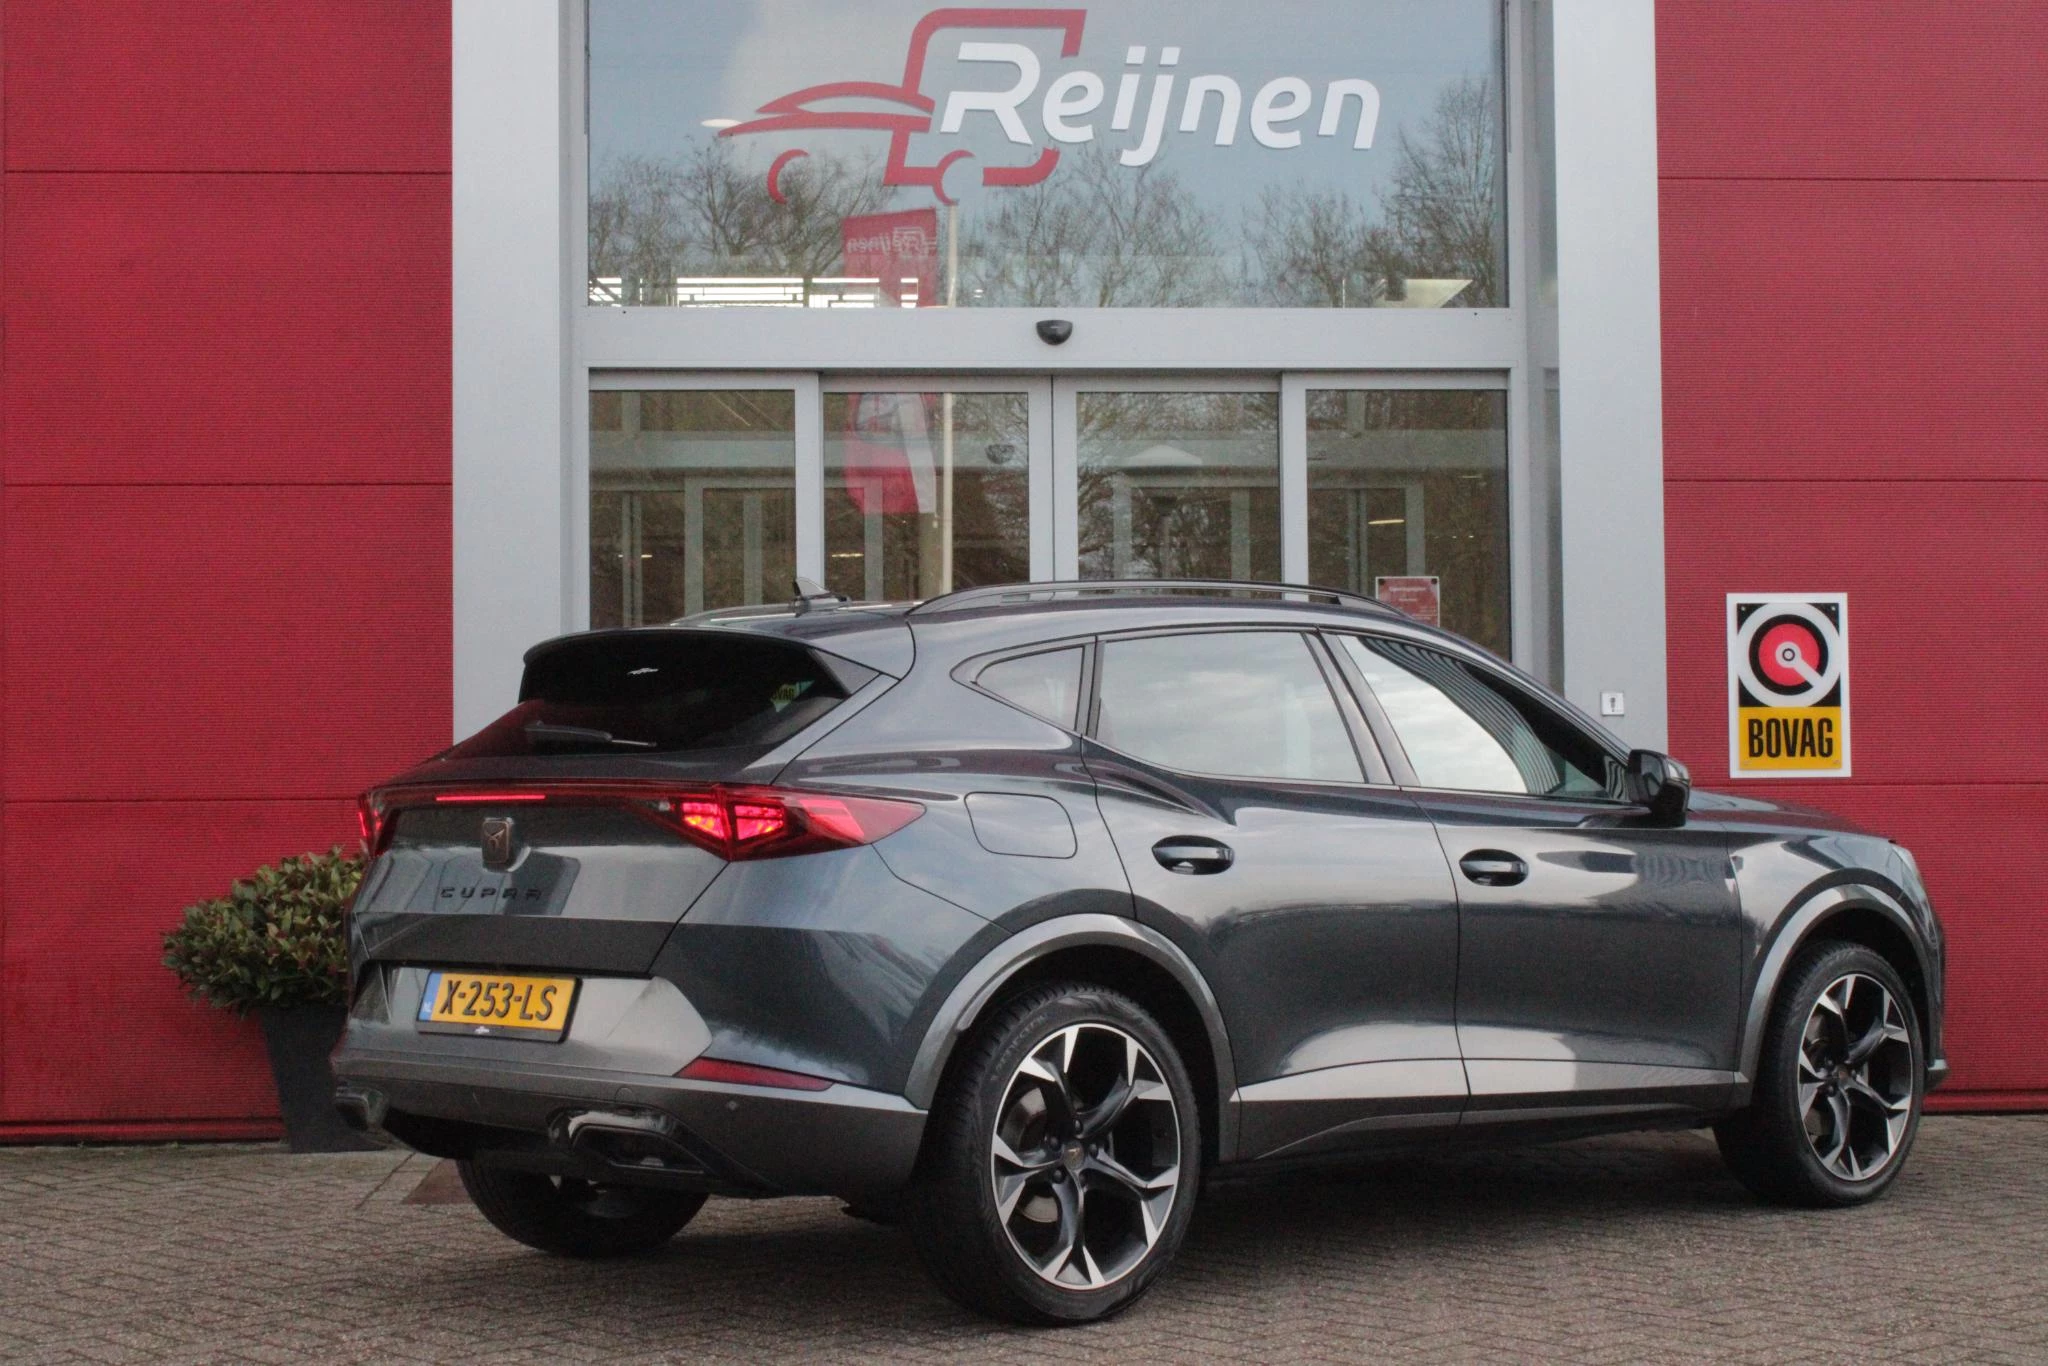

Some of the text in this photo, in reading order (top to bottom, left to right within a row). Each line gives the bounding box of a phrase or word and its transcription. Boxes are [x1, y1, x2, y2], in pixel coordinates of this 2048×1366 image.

[940, 42, 1380, 166] Reijnen
[1748, 717, 1833, 758] BOVAG
[441, 887, 542, 900] CUPRA
[440, 979, 557, 1021] X-253-LS
